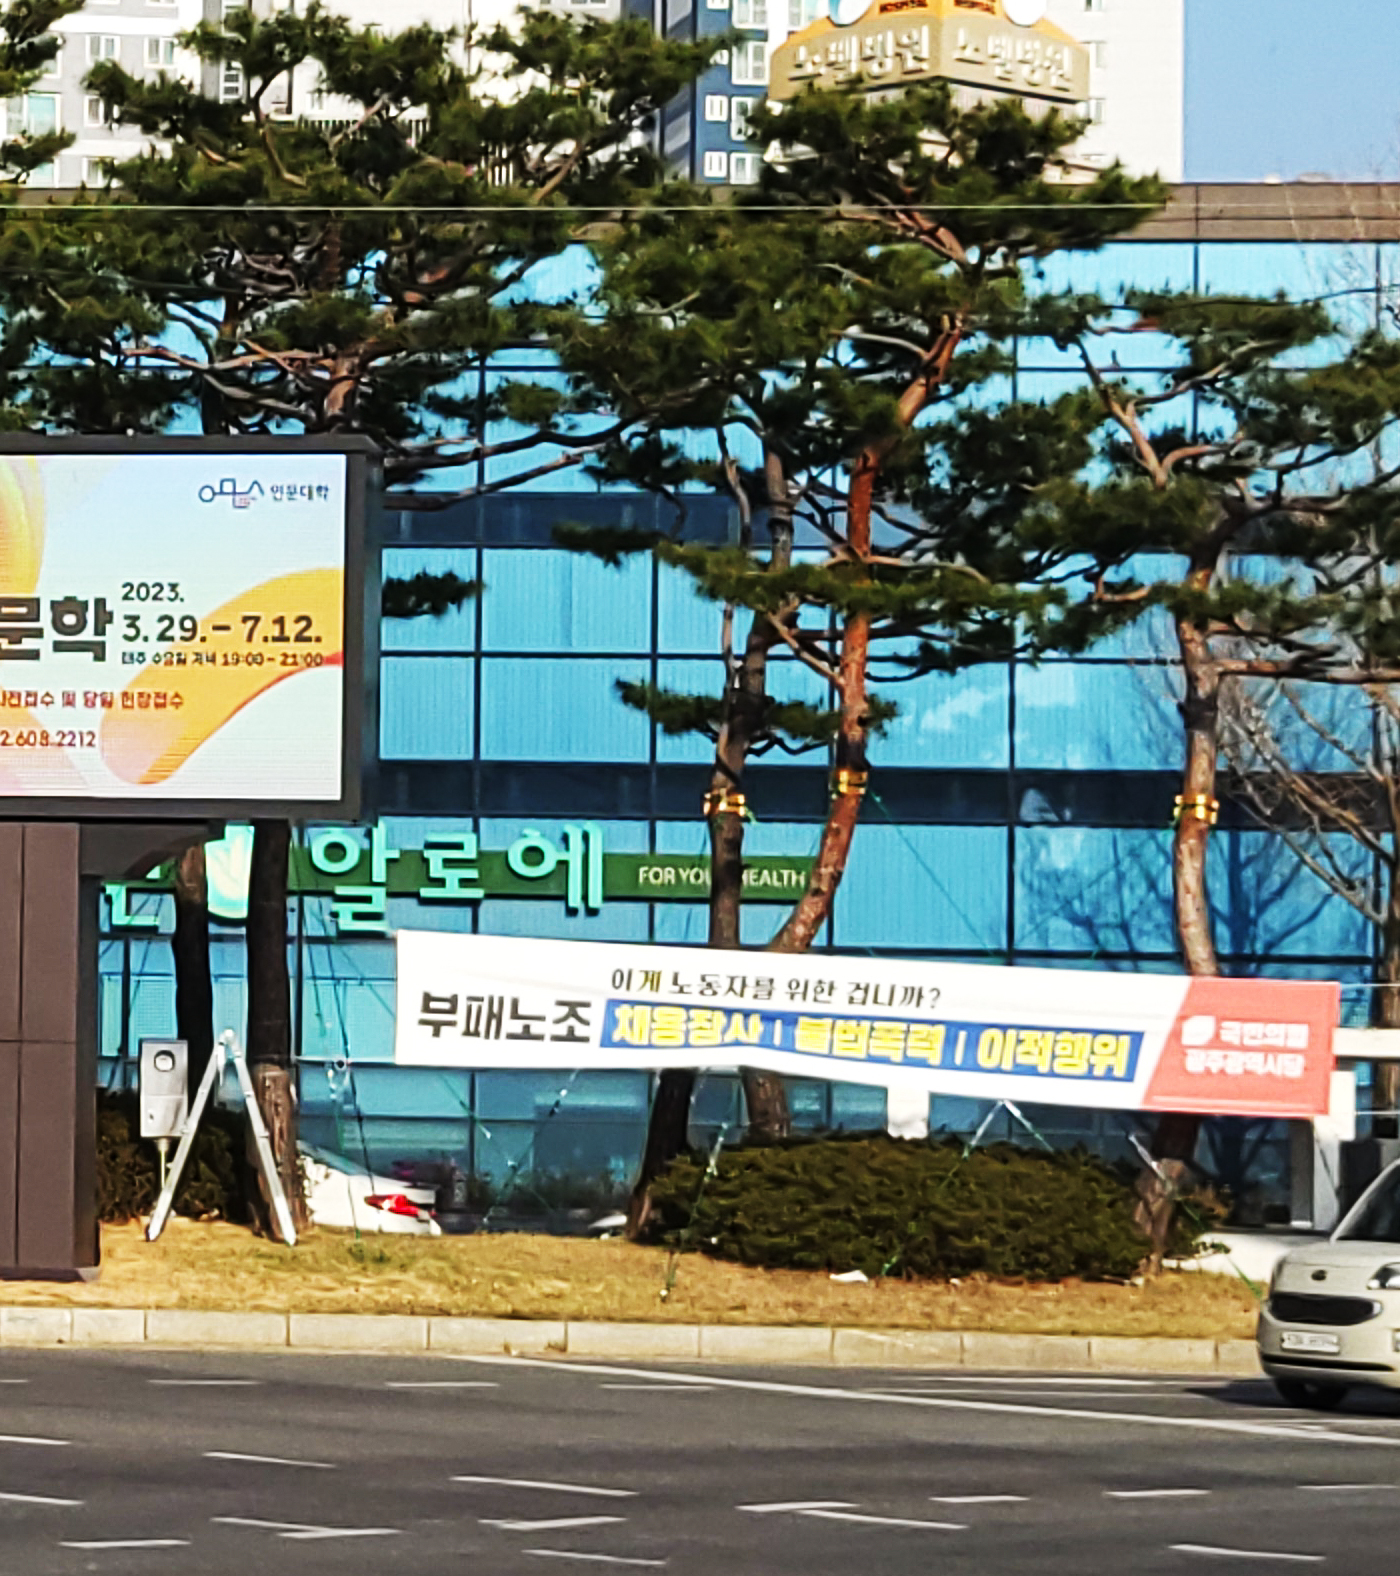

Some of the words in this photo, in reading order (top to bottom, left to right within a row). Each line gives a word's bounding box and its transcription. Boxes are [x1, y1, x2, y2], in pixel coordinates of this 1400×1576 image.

[270, 484, 329, 502] 인문대학
[121, 582, 185, 602] 2023.
[310, 818, 605, 932] 알로에
[638, 866, 676, 886] FOR
[611, 968, 661, 994] 이게
[669, 970, 775, 1001] 노동자를
[787, 977, 838, 1004] 위한
[847, 981, 942, 1009] 겁니까?
[418, 991, 591, 1043] 부패노조
[977, 1028, 1131, 1078] 이적행위
